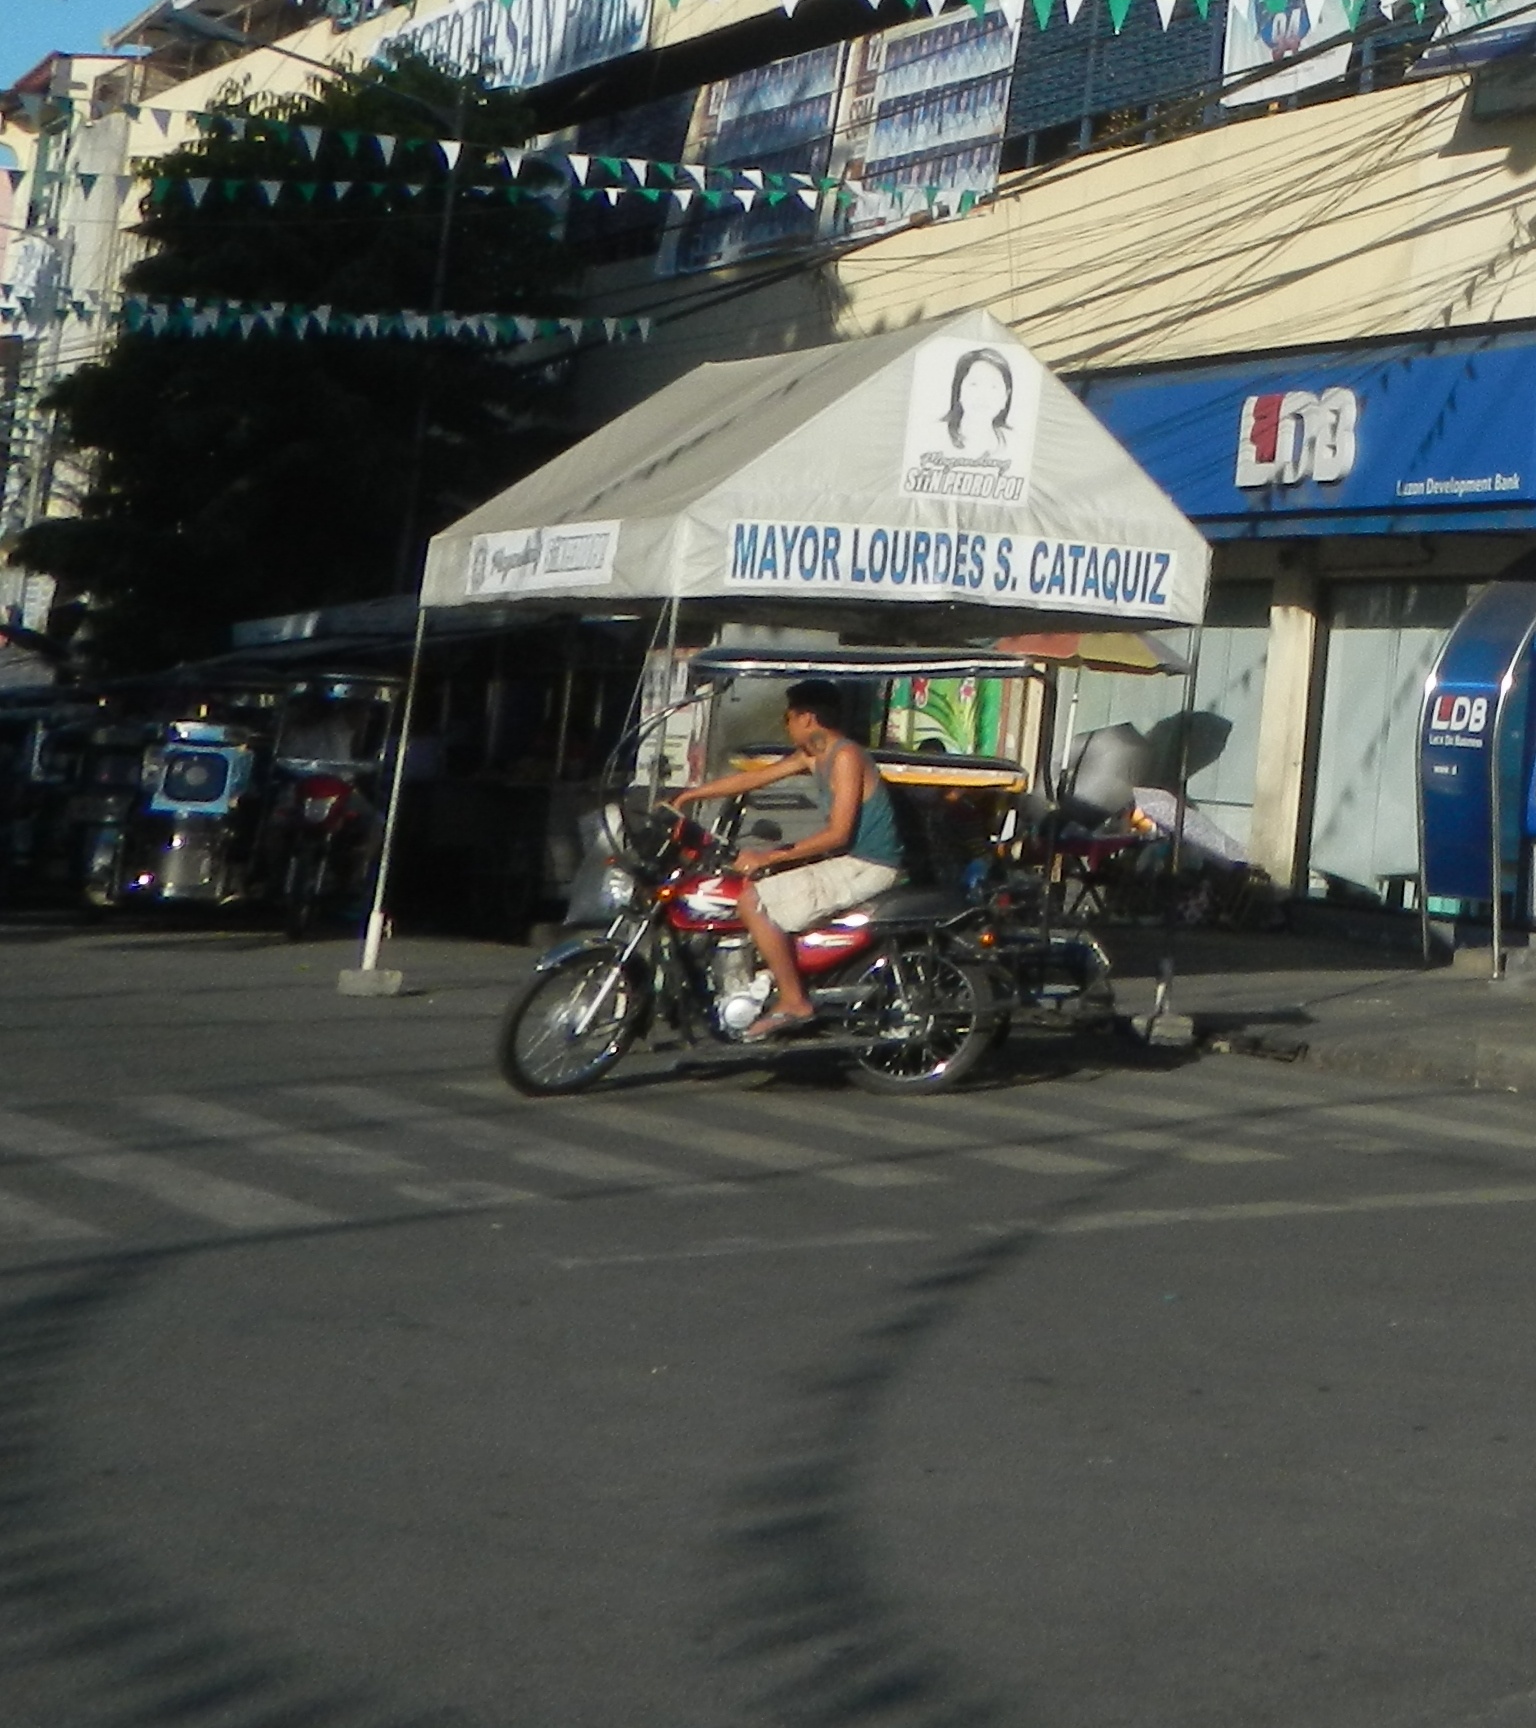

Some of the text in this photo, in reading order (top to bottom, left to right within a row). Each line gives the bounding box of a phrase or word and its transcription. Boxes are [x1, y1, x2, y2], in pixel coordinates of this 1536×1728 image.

[1234, 385, 1358, 488] LDB
[942, 471, 996, 498] PEDRO
[996, 474, 1024, 502] PO!
[1426, 474, 1493, 497] Development
[1494, 473, 1521, 492] Bank
[731, 523, 1172, 606] MAYOR LOURDES S. CATAQUIZ
[1430, 695, 1489, 733] LDB
